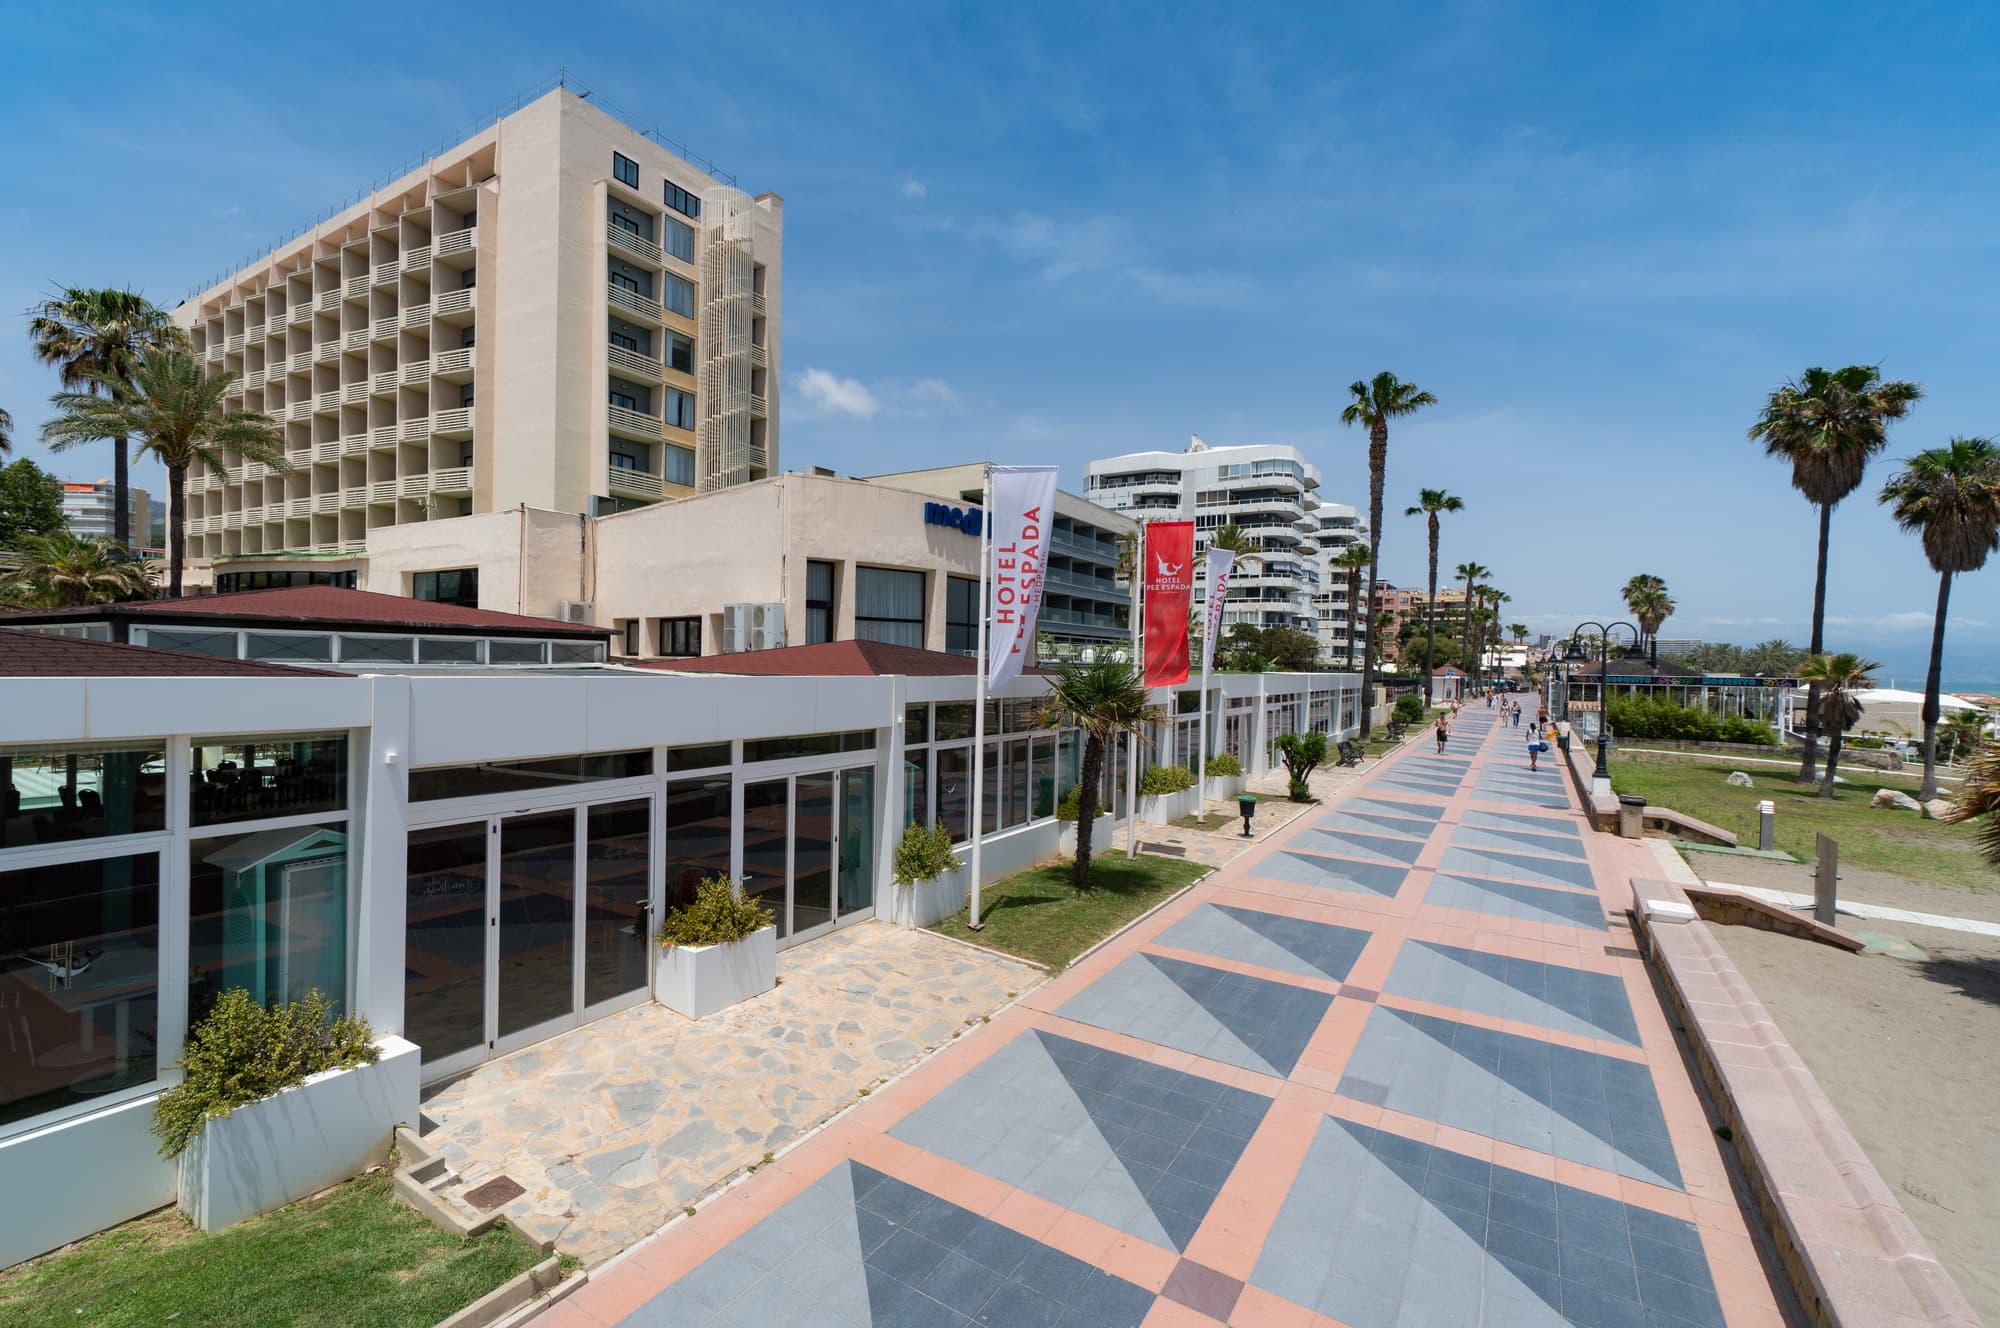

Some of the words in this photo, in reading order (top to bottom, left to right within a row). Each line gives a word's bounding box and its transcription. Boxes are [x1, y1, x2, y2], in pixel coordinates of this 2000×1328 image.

[996, 541, 1017, 625] HOTEL
[1020, 506, 1041, 605] ESPADA
[1207, 594, 1216, 641] HOTEL
